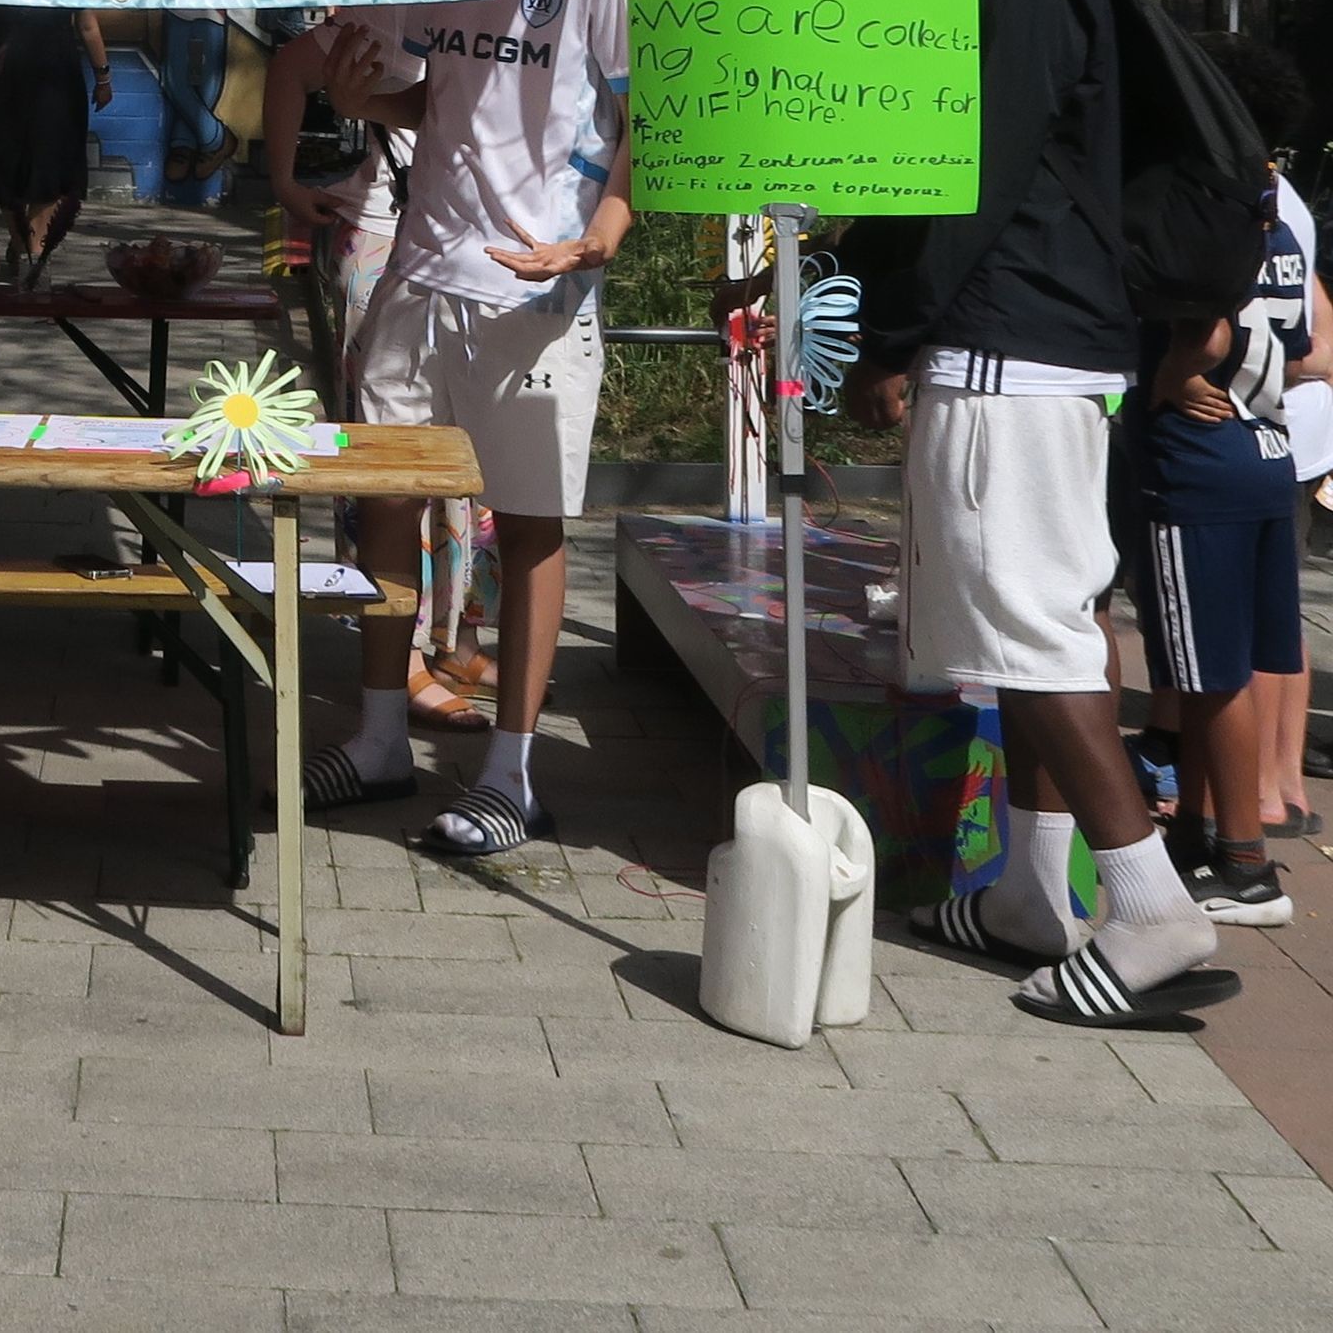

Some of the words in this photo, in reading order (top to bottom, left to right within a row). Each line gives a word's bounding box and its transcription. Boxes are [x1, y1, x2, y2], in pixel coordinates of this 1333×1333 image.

[736, 0, 845, 44] are
[473, 32, 552, 69] CGM
[638, 43, 693, 82] ng
[932, 86, 976, 114] for
[641, 126, 683, 145] Free
